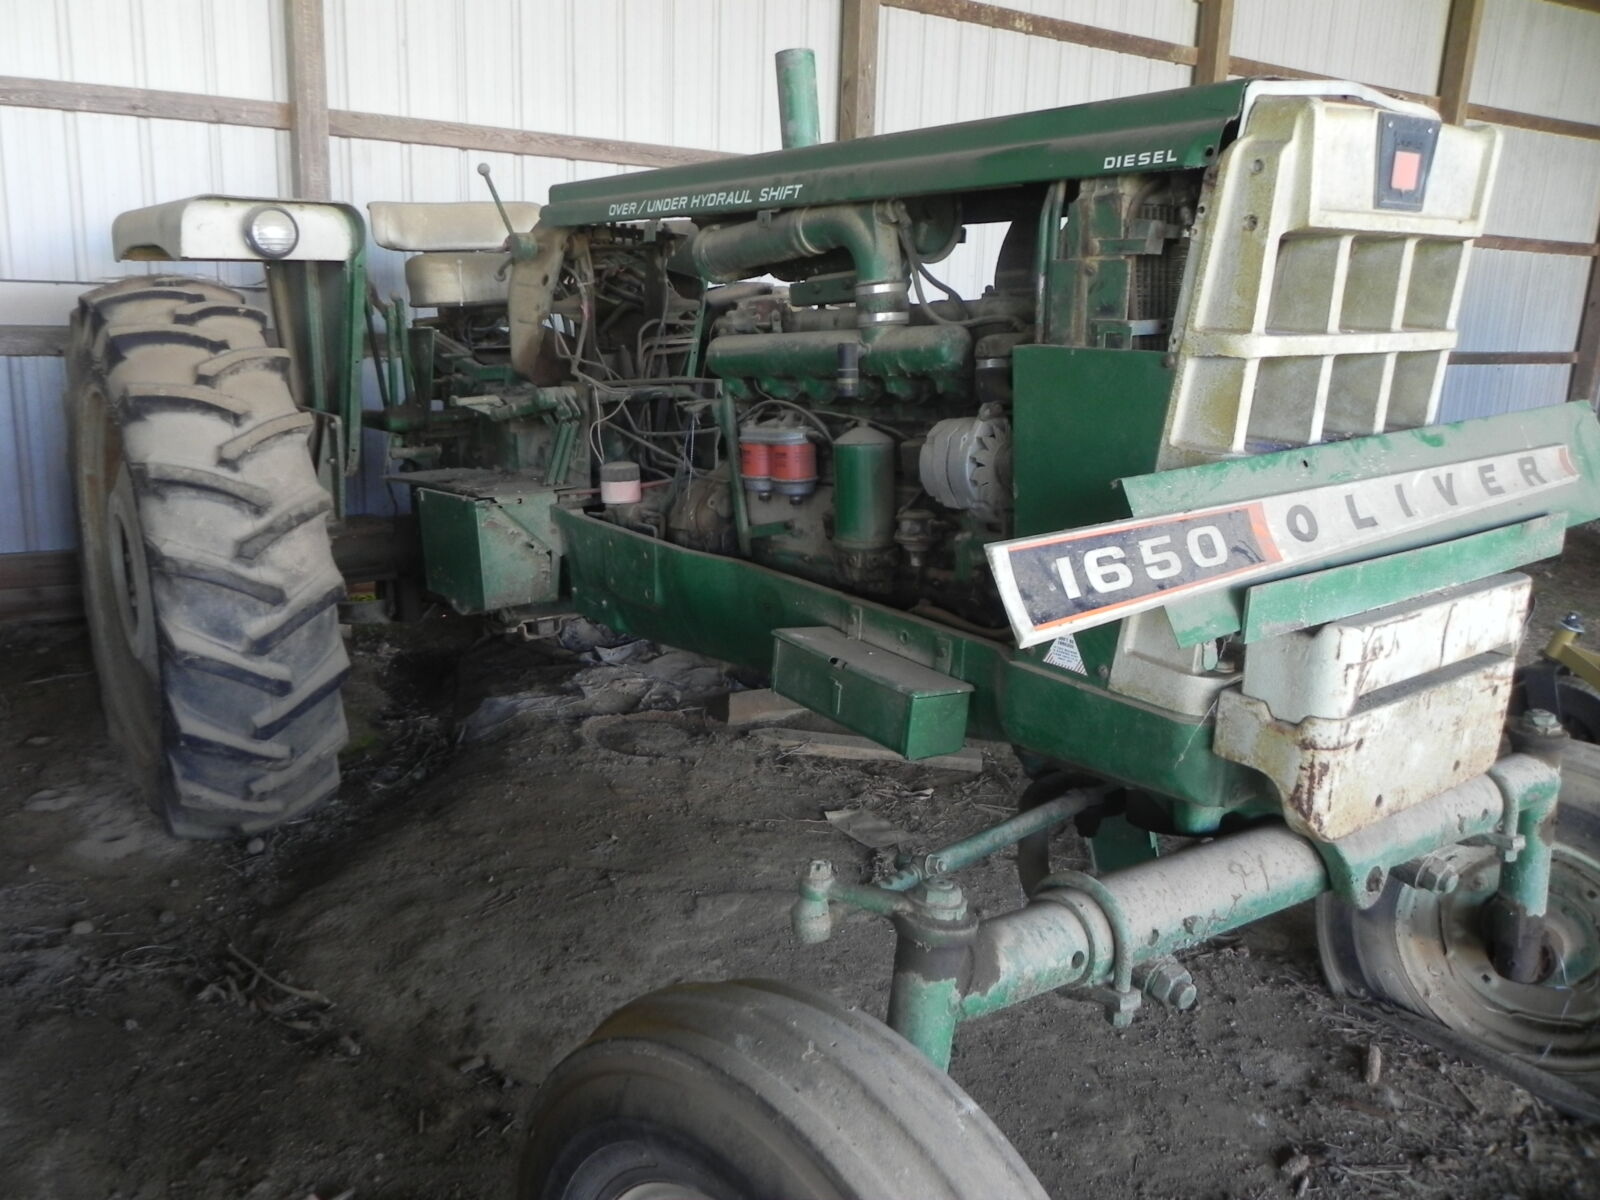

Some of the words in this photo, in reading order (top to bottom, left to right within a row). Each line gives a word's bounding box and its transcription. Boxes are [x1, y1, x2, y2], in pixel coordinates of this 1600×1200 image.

[1103, 149, 1178, 170] DIESEL
[690, 189, 752, 208] HYDRAUL
[759, 184, 803, 202] SHIFT
[1055, 525, 1229, 600] 1650
[1286, 455, 1548, 543] OLIVER
